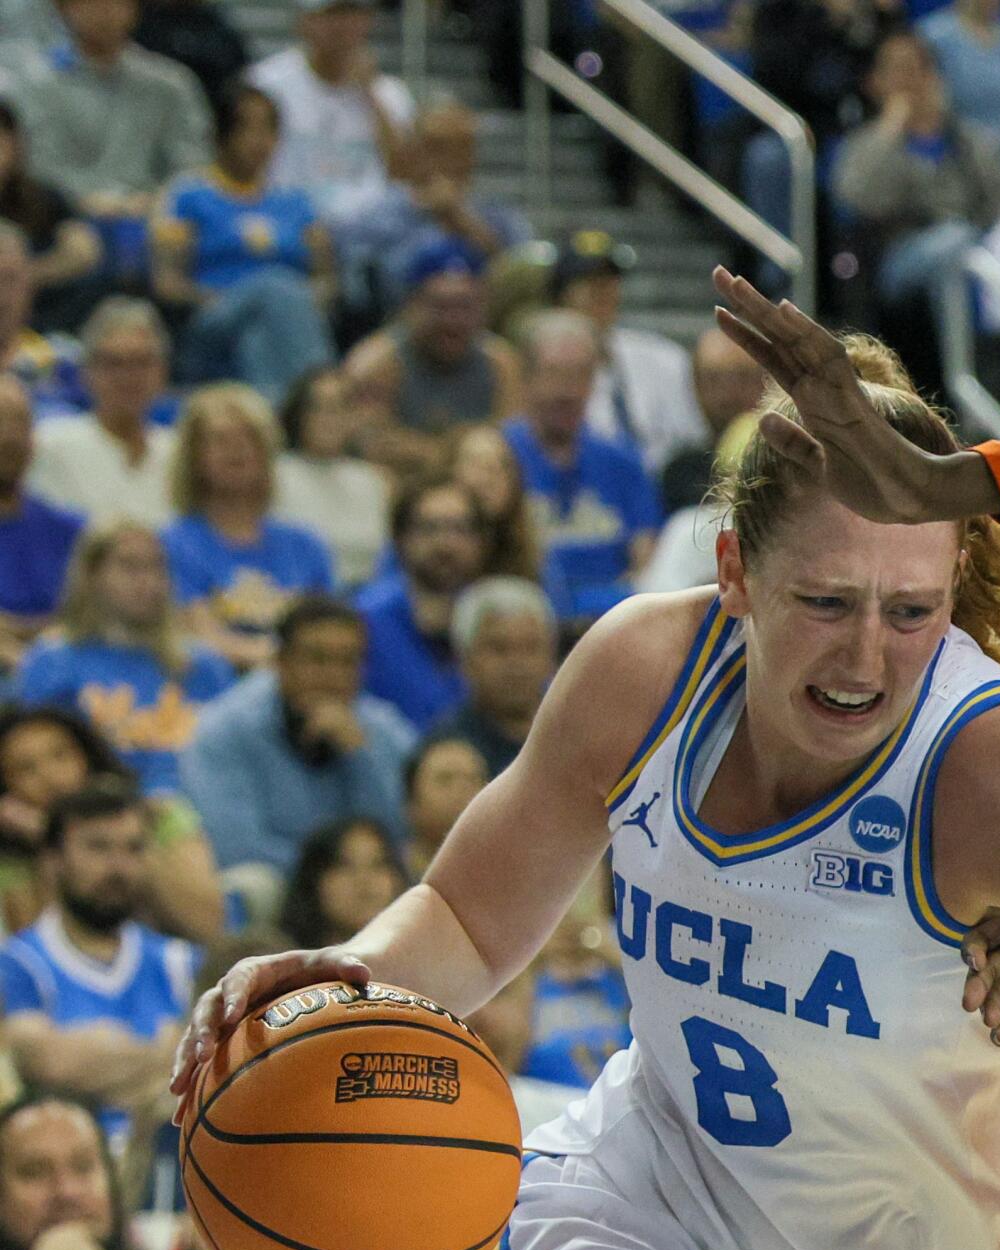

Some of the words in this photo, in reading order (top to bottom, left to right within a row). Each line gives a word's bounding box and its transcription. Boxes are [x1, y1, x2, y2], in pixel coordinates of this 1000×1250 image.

[855, 820, 901, 841] NCAA
[614, 871, 881, 1039] UCLA
[364, 1055, 428, 1073] MARCH
[375, 1072, 458, 1097] MADNESS
[681, 1016, 792, 1147] 8
